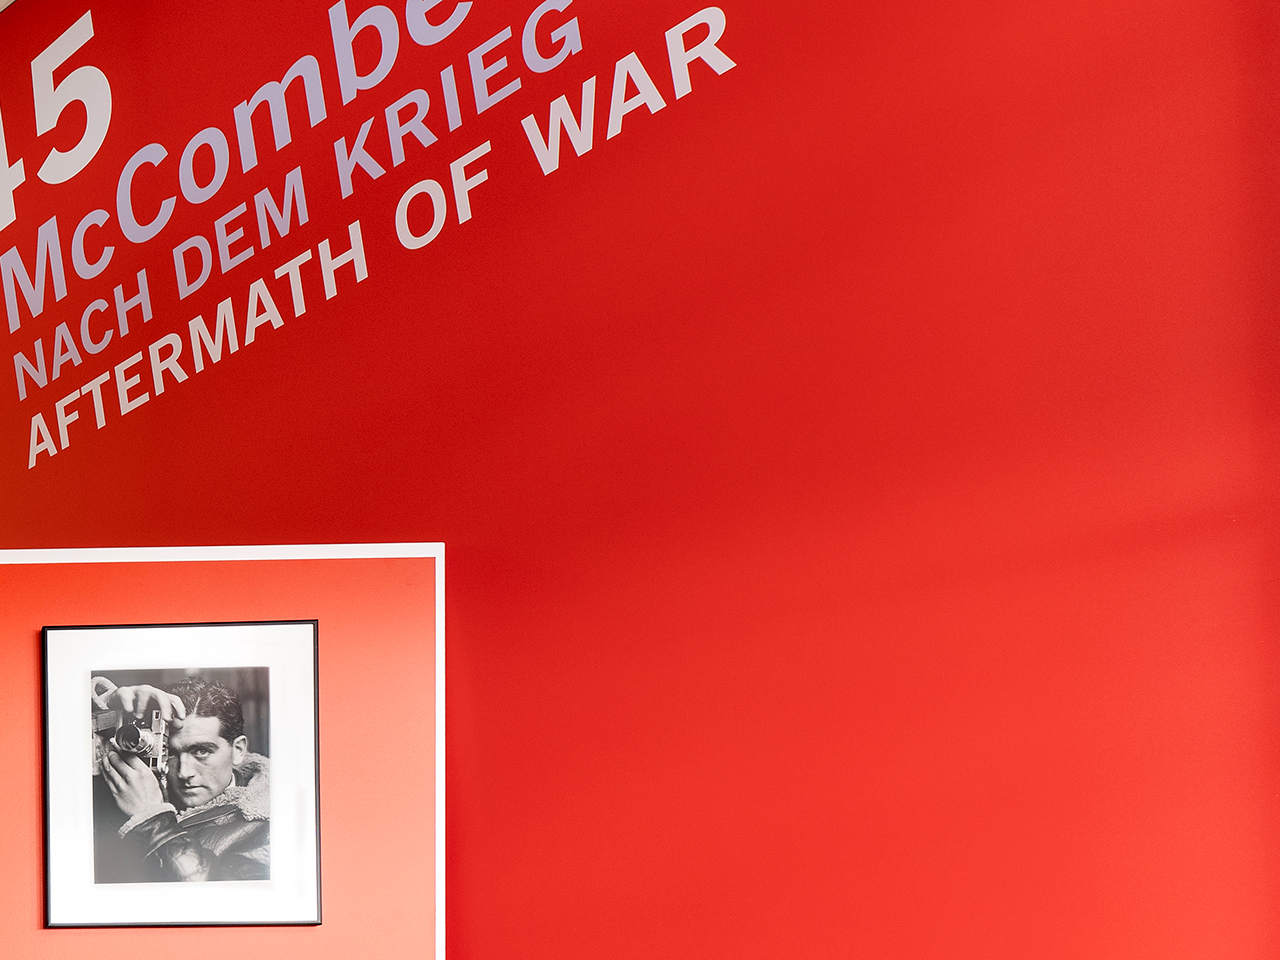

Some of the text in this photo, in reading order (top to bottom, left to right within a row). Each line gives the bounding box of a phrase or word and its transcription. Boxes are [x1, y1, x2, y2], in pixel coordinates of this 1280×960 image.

[0, 0, 474, 333] McCombe
[14, 0, 583, 401] NACH DEM KRIEG
[29, 7, 738, 469] AFTERMATH OF WAR
